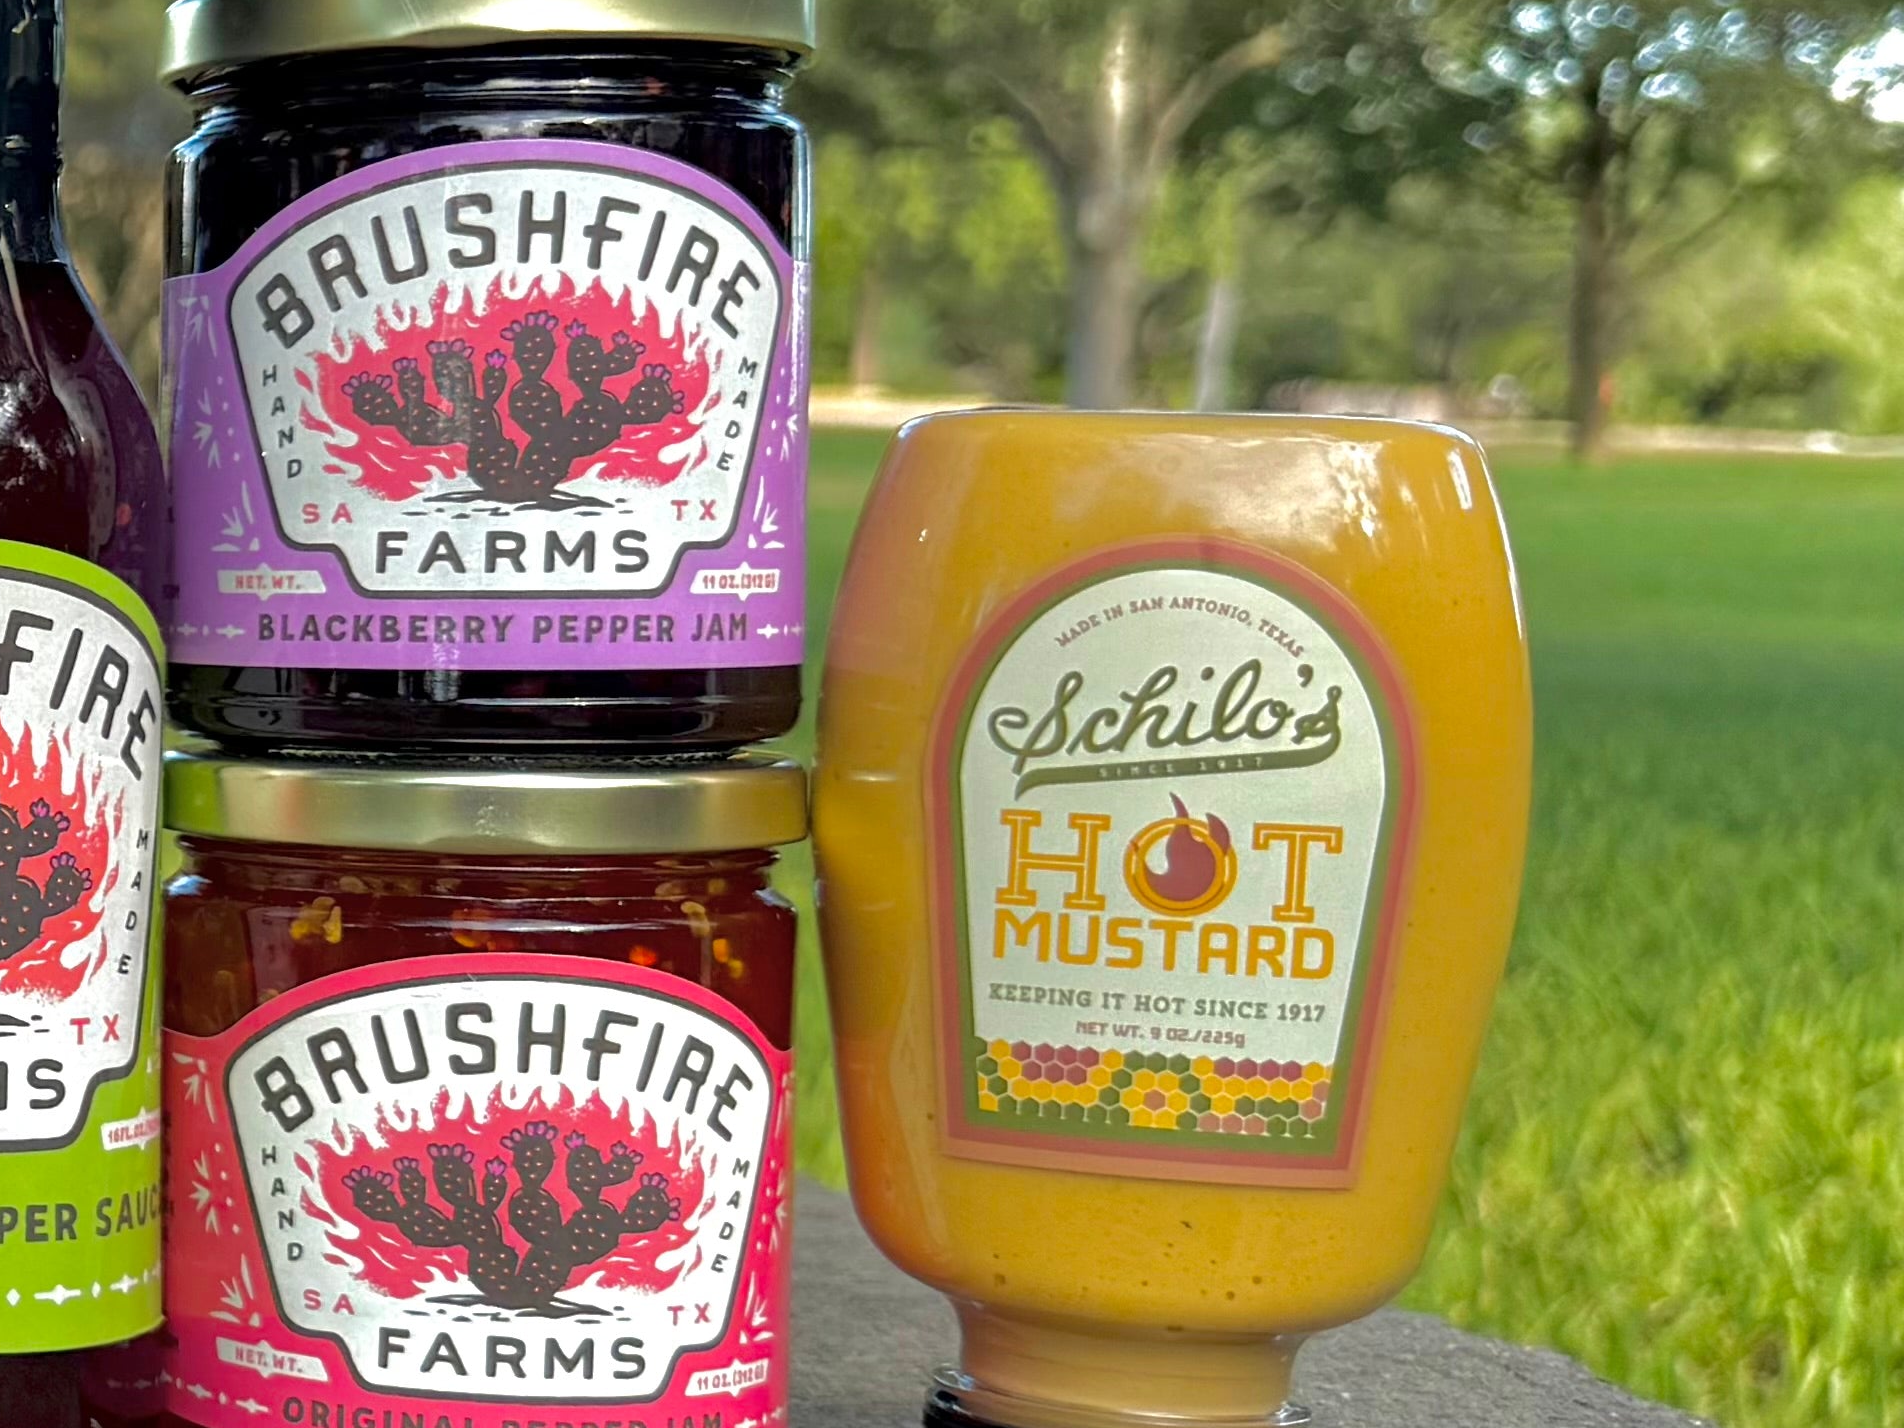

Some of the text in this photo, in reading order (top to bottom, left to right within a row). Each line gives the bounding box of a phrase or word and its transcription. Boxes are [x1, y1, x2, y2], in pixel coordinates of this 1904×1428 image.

[255, 190, 759, 349] BRUSHFIRE
[262, 365, 303, 478] HAND
[717, 358, 758, 471] MADE
[303, 503, 353, 524] SA
[671, 499, 716, 521] TX
[375, 530, 650, 574] FARMS
[258, 612, 746, 643] BLACKBERRY PEPPER JAM
[1054, 615, 1101, 648] MADE
[1103, 604, 1124, 621] IN
[1129, 596, 1163, 614] SAN
[1258, 618, 1304, 658] TEXAS
[988, 658, 1341, 776] Schilo's
[996, 806, 1343, 924] HOT
[116, 828, 149, 976] MADE
[994, 908, 1334, 980] MUSTARD
[71, 1015, 120, 1046] TX
[989, 982, 1326, 1022] KEEPING IT HOT SINCE 1917
[1076, 1021, 1108, 1036] NET
[1113, 1023, 1141, 1039] WT.
[1150, 1026, 1161, 1040] 9
[254, 1002, 753, 1141] BRUSHFIRE
[262, 1145, 304, 1261] HAND
[711, 1158, 750, 1272] MADE
[304, 1289, 354, 1315] SA
[668, 1303, 711, 1326] TX
[378, 1327, 646, 1380] FARMS
